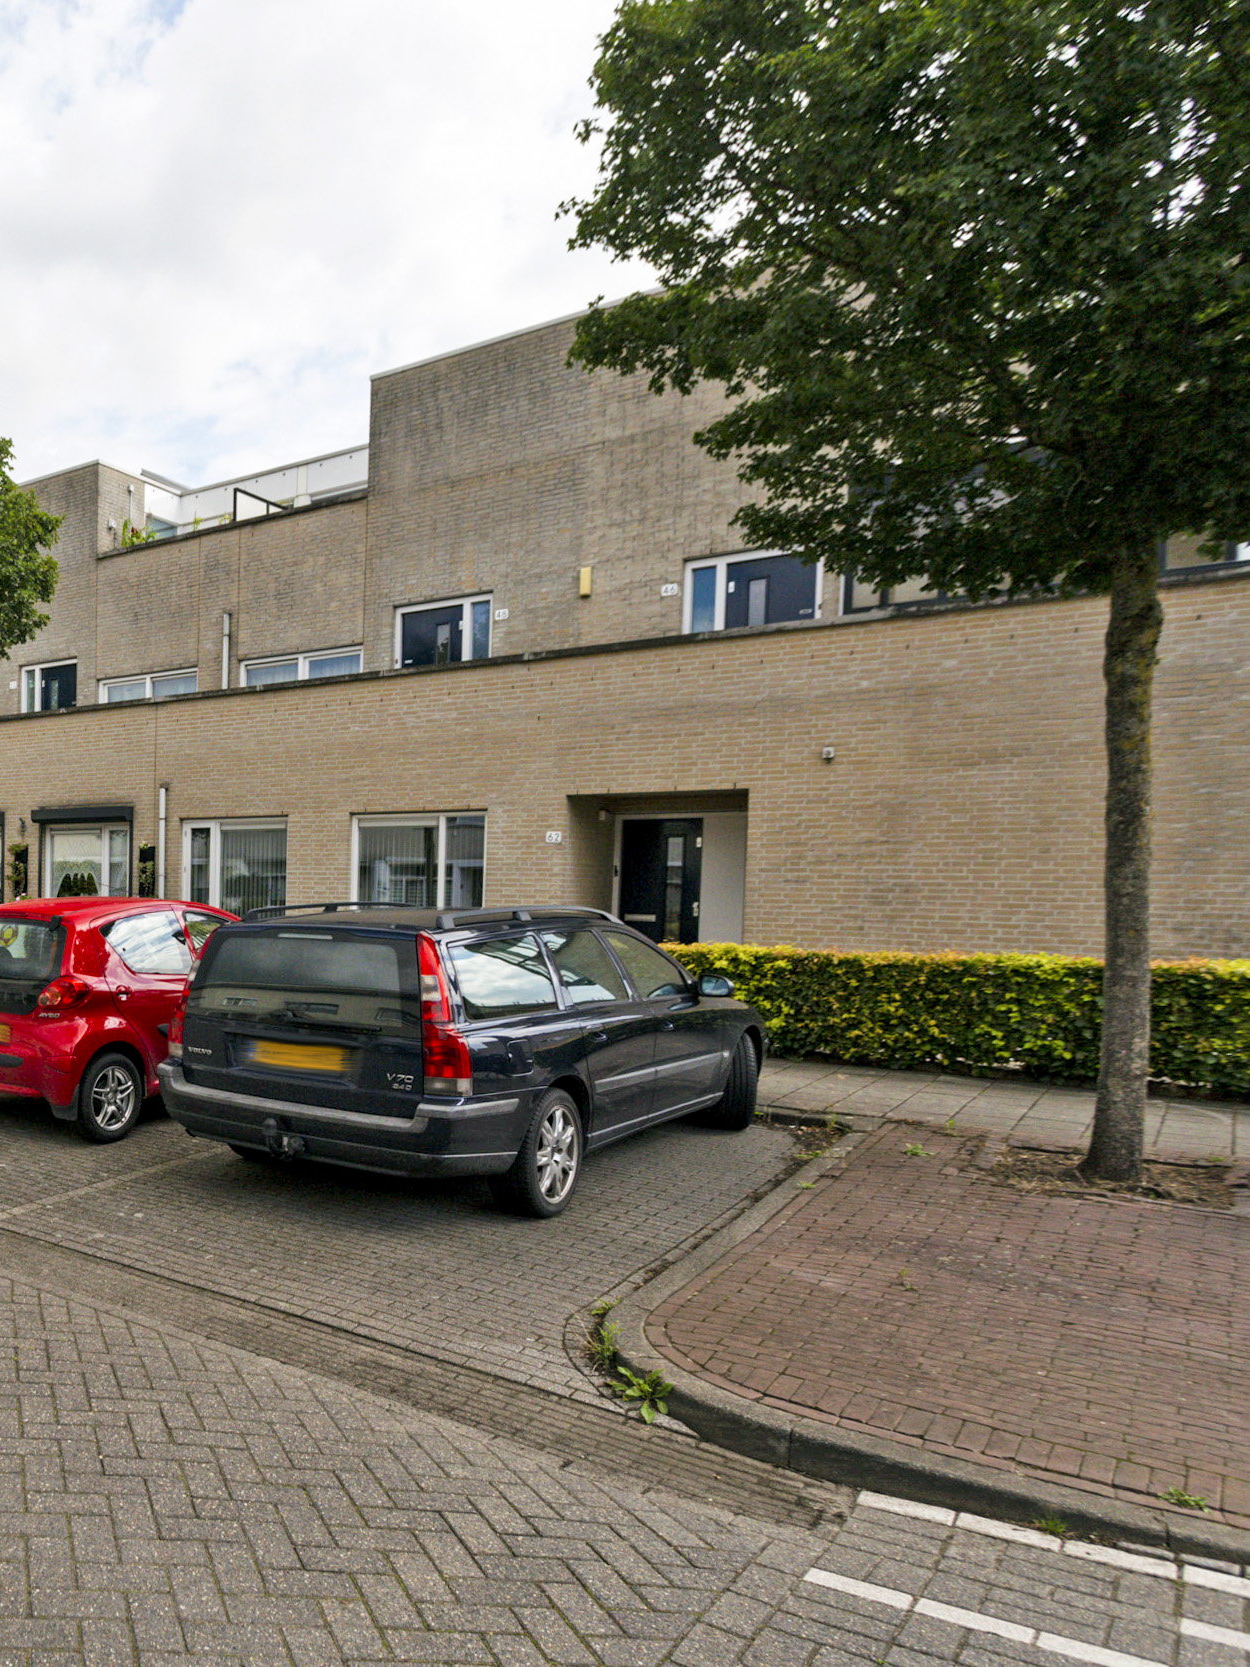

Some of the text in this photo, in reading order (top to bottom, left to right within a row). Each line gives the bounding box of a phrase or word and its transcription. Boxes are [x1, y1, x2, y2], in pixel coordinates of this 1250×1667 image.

[547, 832, 560, 842] 62
[187, 1046, 212, 1055] VOLVO
[386, 1073, 414, 1083] V70
